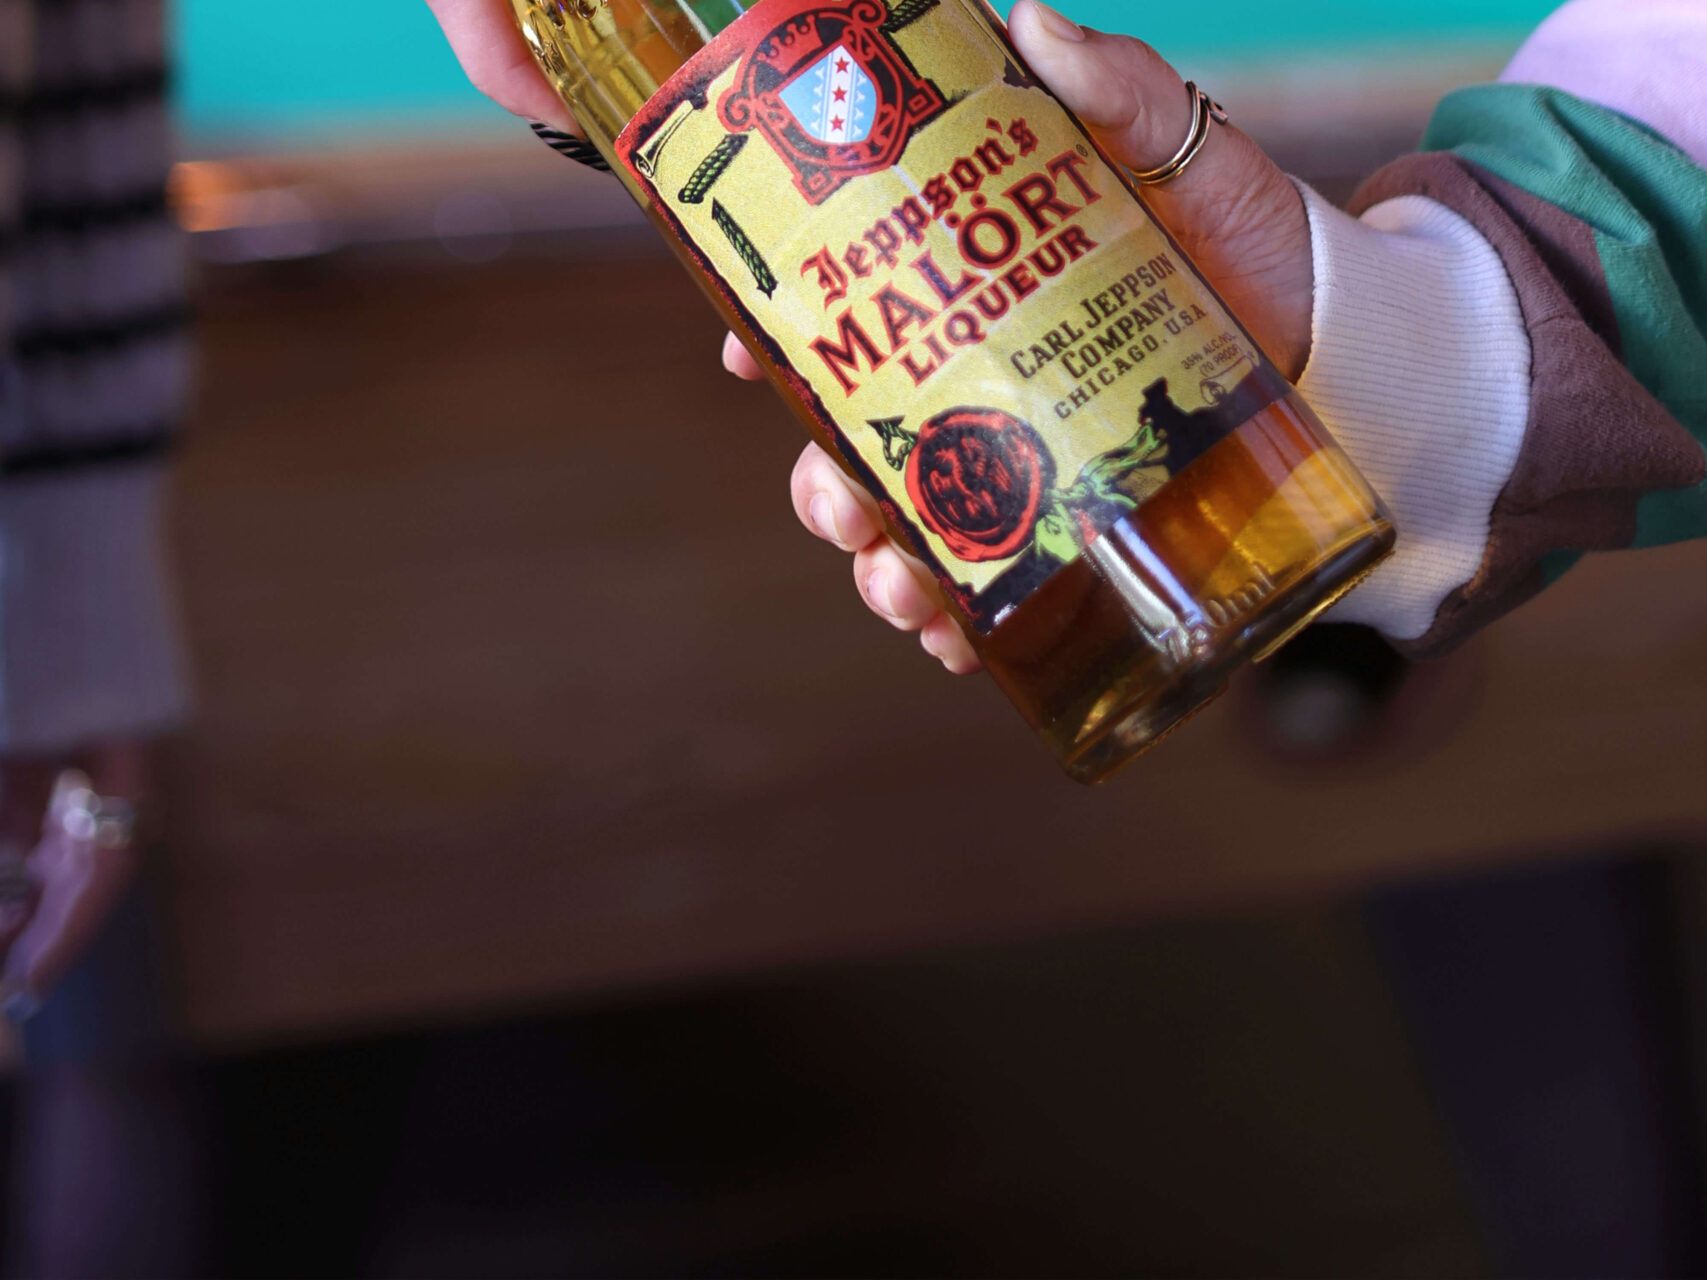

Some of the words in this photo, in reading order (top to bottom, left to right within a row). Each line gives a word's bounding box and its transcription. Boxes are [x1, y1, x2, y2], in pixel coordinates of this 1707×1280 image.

[800, 118, 1037, 310] Jeppson's
[809, 150, 1102, 397] MALÖRT
[898, 225, 1098, 386] LIQUEUR
[1010, 320, 1085, 379] CARL
[1080, 252, 1177, 329] JEPPSON
[1060, 288, 1176, 379] COMPANY
[1181, 351, 1203, 370] 35%
